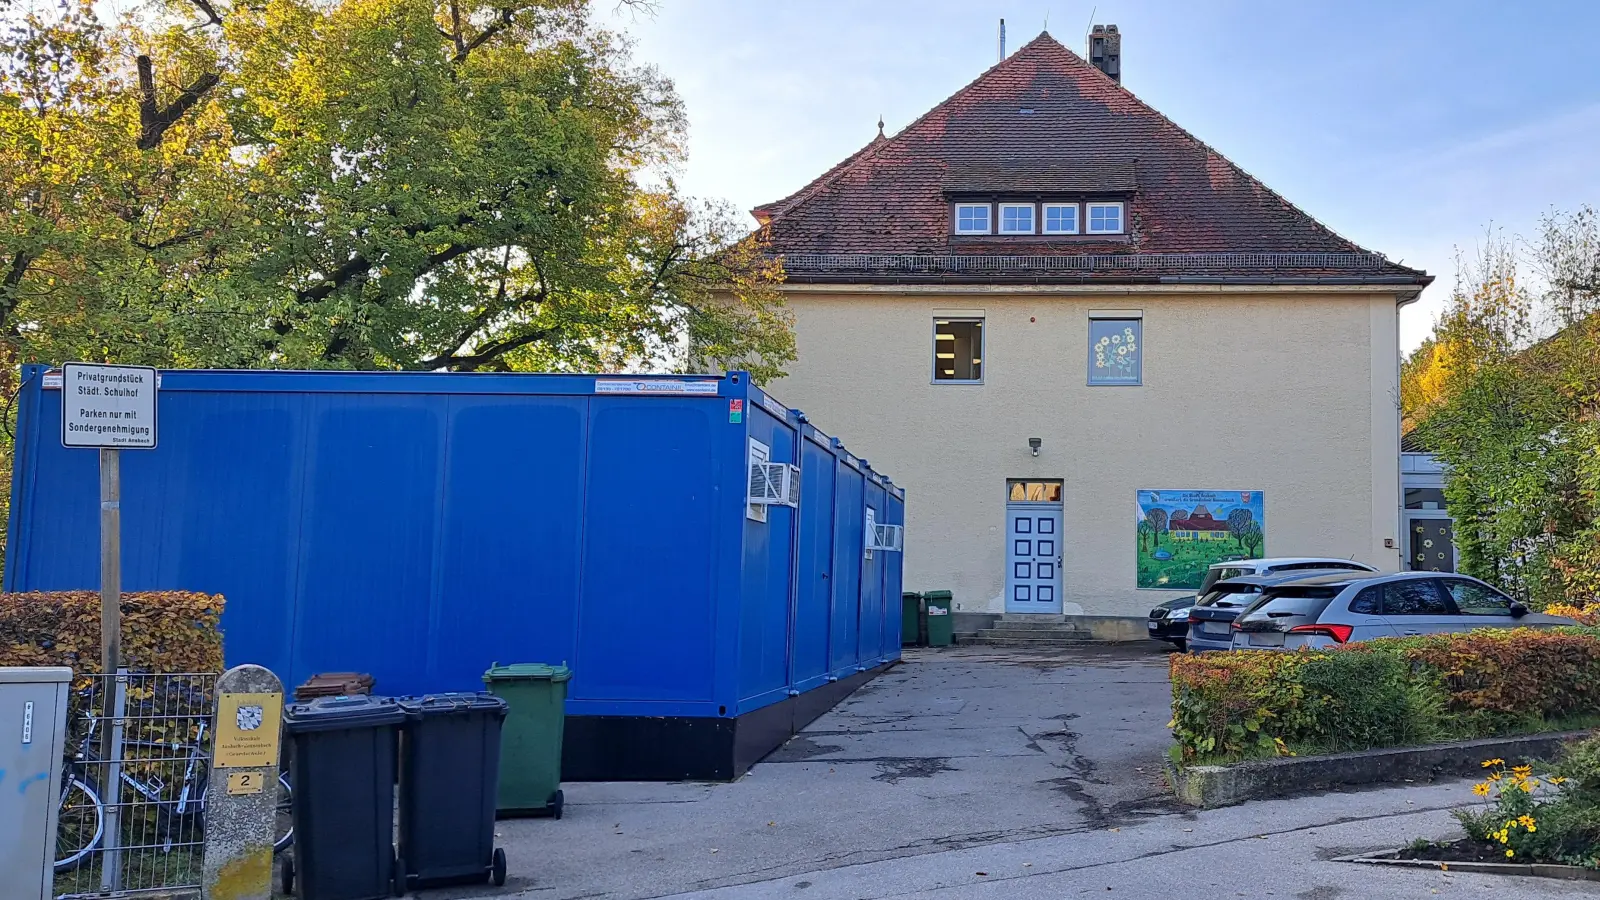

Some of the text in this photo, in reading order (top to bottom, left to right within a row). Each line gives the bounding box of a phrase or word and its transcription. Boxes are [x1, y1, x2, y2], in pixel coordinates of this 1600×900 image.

[77, 371, 144, 384] Privatgrundstück
[78, 385, 139, 398] Städt. Schulhof
[80, 408, 137, 420] Parken nur mit
[69, 422, 150, 436] Sondergenehmigung
[240, 774, 250, 787] 2
